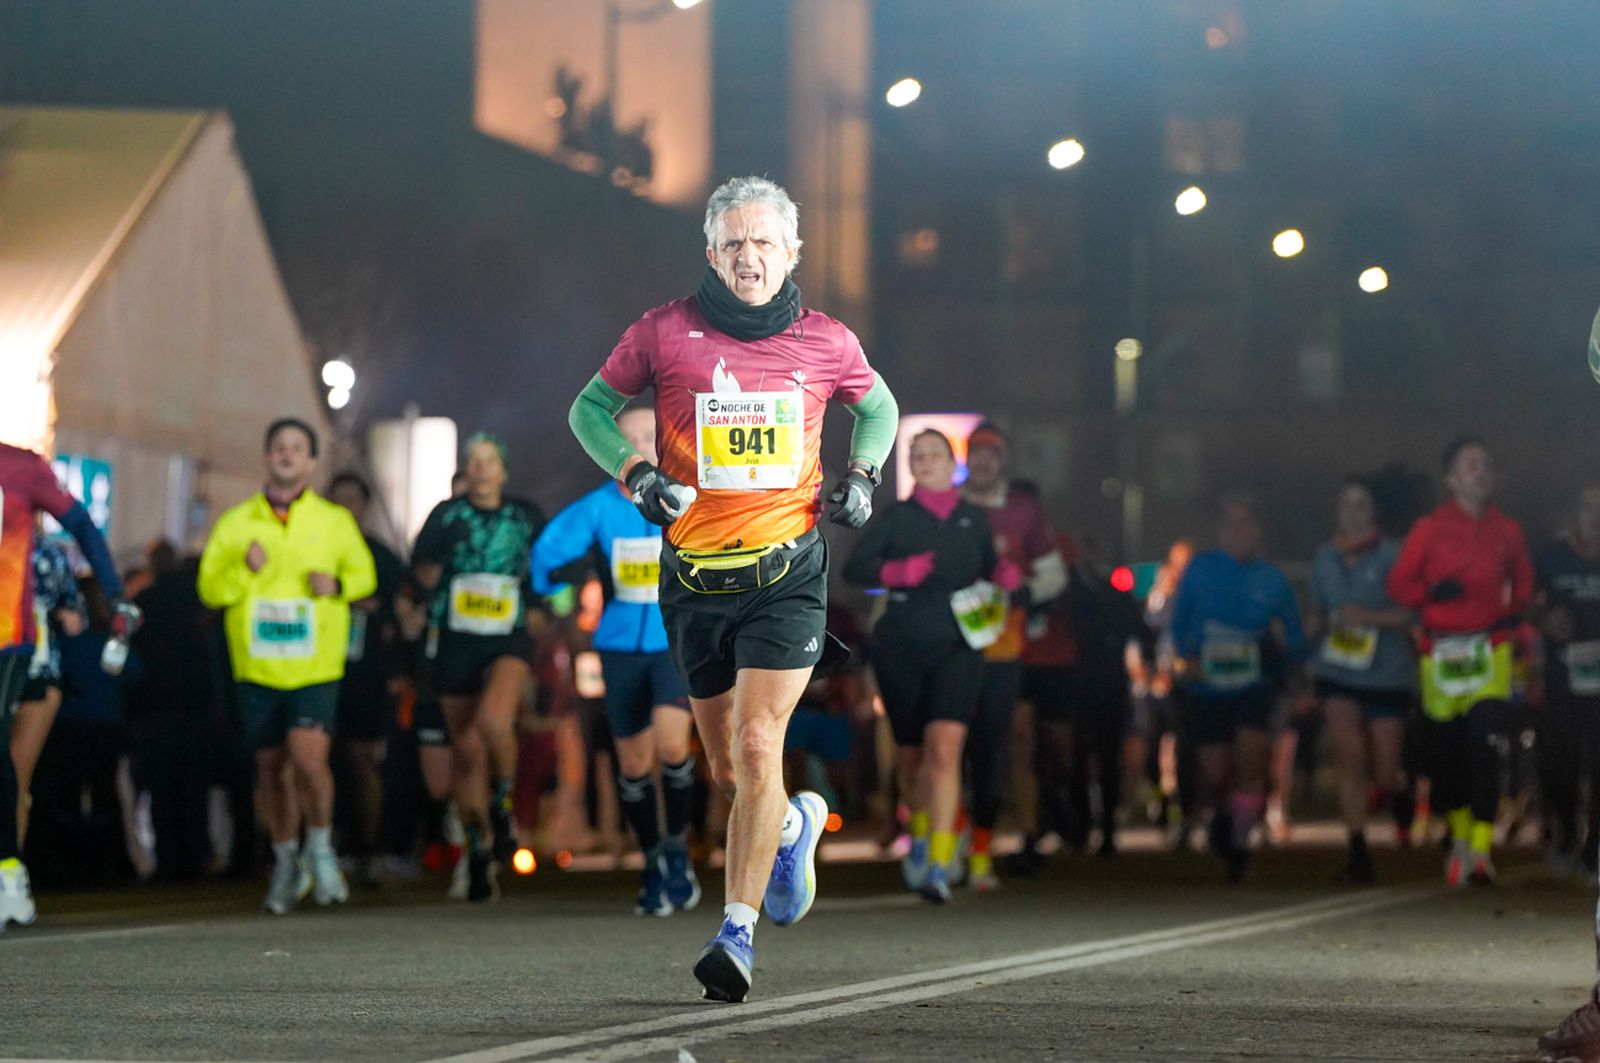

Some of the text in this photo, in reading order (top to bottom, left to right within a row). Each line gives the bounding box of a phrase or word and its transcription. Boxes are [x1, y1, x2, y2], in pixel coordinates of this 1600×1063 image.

[720, 403, 752, 413] NOCHE
[753, 403, 766, 412] DE
[708, 415, 730, 425] SAN
[728, 427, 775, 456] 941
